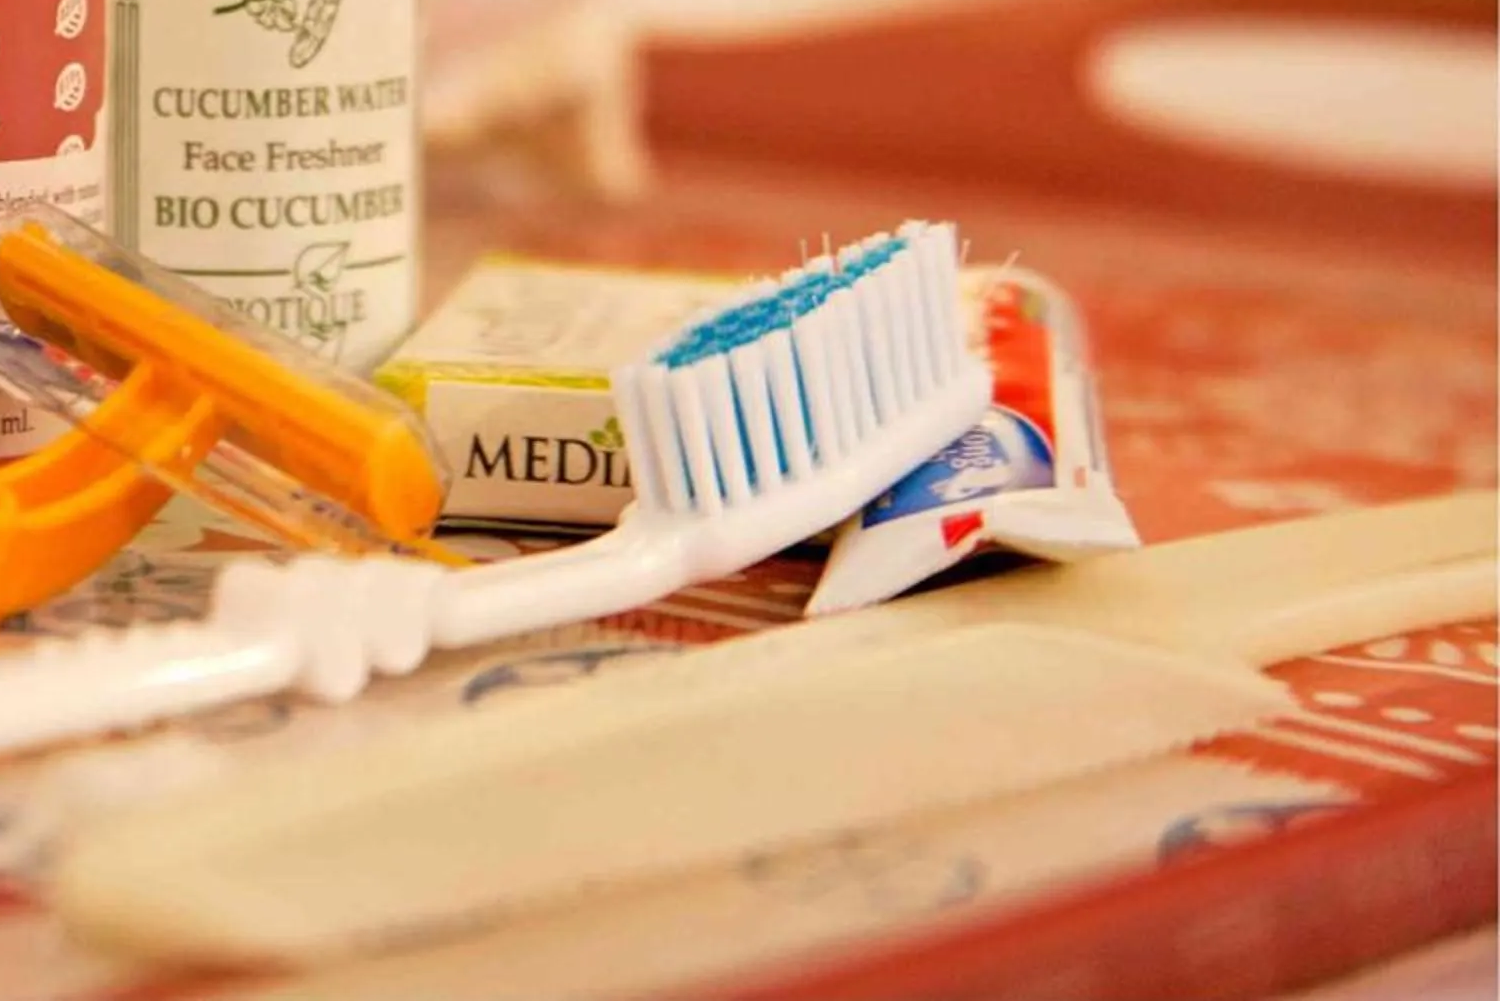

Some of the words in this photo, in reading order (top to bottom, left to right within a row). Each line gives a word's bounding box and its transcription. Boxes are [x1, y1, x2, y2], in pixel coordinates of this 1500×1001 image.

[153, 85, 331, 119] CUCUMBER
[182, 141, 256, 172] Face
[265, 139, 387, 172] Freshner
[154, 195, 220, 229] BIO
[230, 183, 405, 230] CUCUMBER
